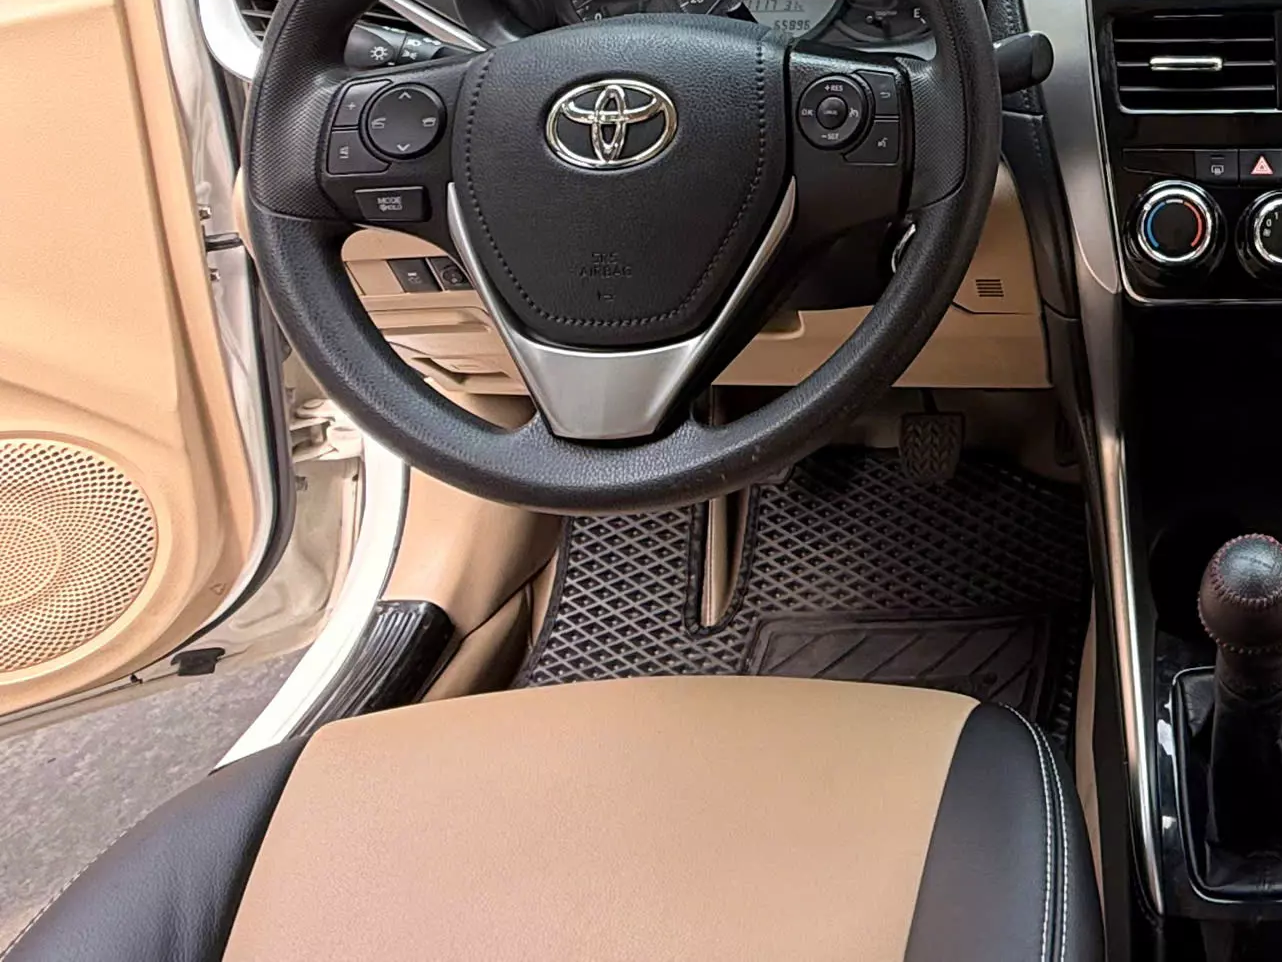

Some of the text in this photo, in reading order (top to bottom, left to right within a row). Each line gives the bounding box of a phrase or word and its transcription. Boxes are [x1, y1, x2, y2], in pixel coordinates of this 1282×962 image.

[914, 8, 920, 18] E
[377, 196, 402, 204] MODE
[1266, 219, 1272, 227] 0
[579, 265, 632, 278] AIRBAG
